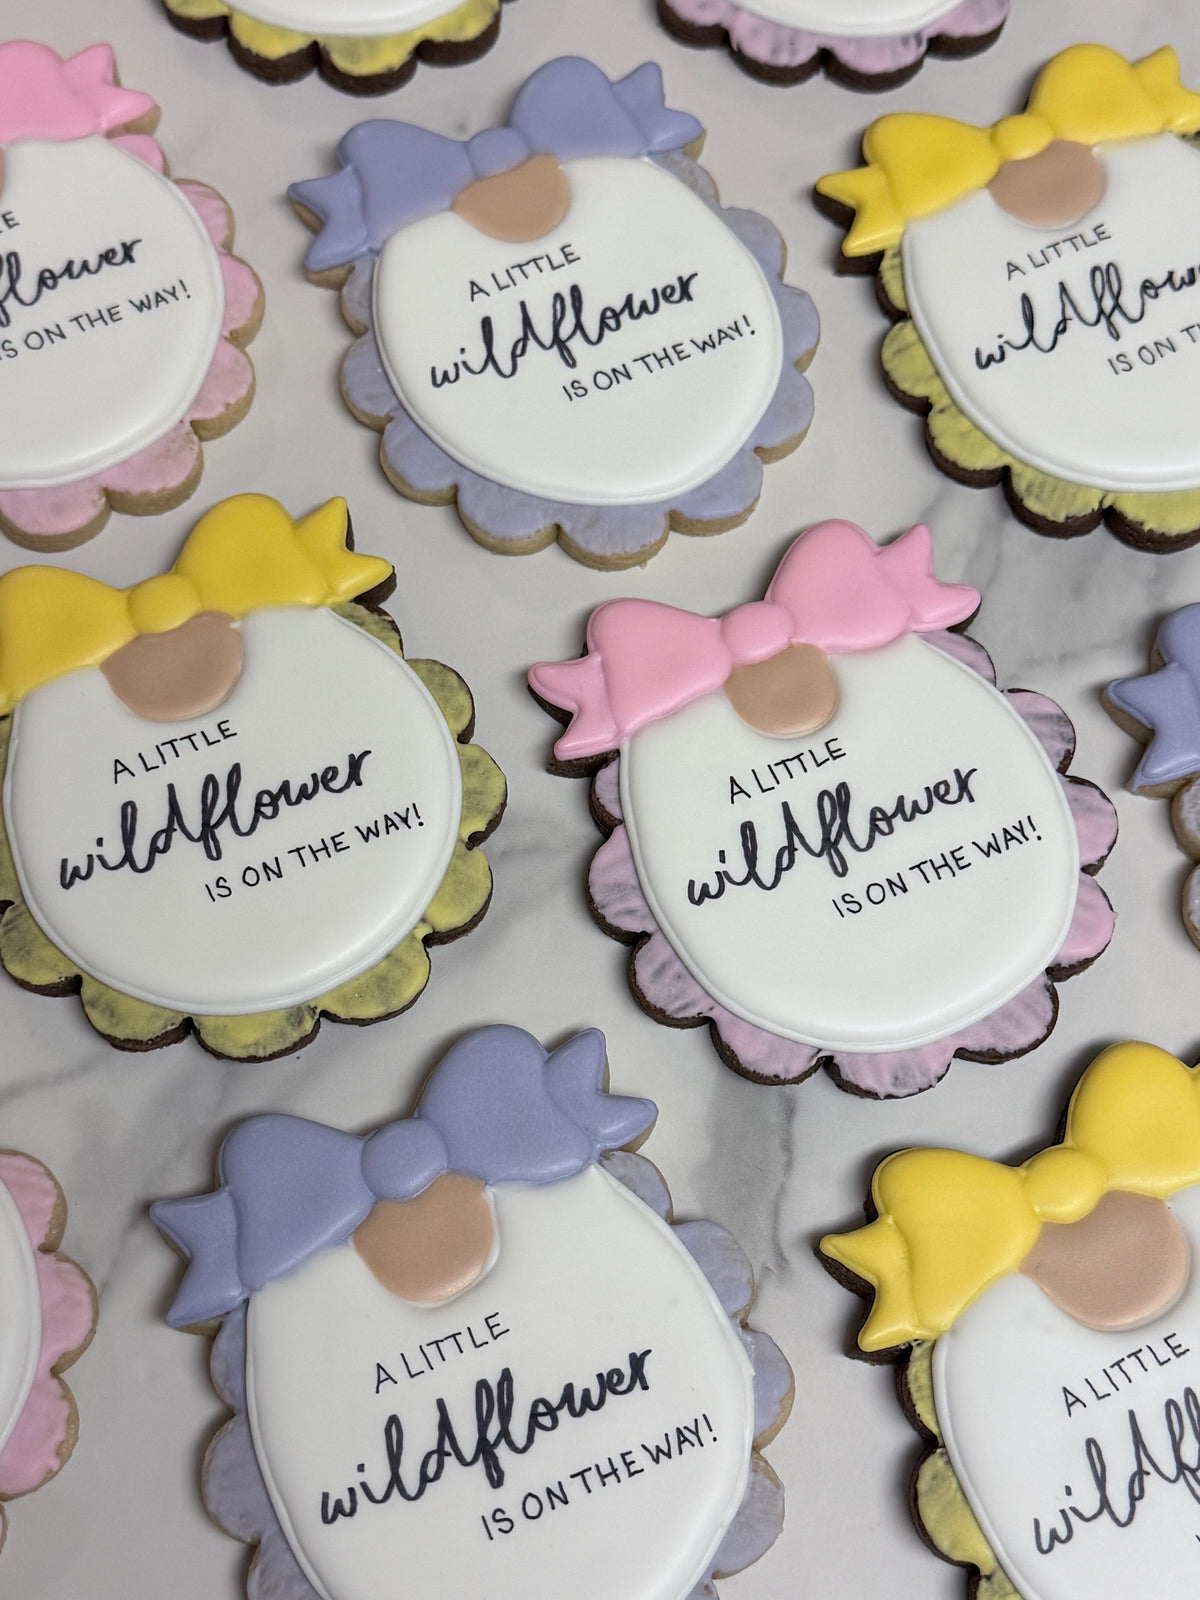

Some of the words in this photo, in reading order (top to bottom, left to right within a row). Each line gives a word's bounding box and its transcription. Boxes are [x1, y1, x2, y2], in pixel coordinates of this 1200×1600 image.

[468, 279, 491, 303] A
[490, 243, 582, 292] LITTLE
[1006, 261, 1027, 282] A
[1026, 223, 1112, 269] LITTLE
[0, 339, 19, 359] S
[23, 323, 67, 351] ON
[68, 304, 124, 332] THE
[127, 279, 192, 314] WAY!
[430, 272, 699, 389] wildflower
[561, 379, 589, 402] IS
[592, 362, 633, 391] ON
[632, 342, 692, 374] THE
[689, 314, 757, 354] WAY!
[974, 261, 1200, 371] wildflow
[1107, 352, 1134, 376] IS
[1137, 336, 1177, 366] ON
[113, 758, 136, 785] A
[137, 719, 238, 773] LITTLE
[729, 775, 752, 805] A
[750, 737, 847, 794] LITTLE
[59, 749, 373, 891] wildflower
[204, 875, 233, 903] IS
[241, 856, 284, 888] ON
[286, 831, 351, 869] THE
[354, 802, 425, 844] WAY!
[687, 767, 979, 907] wildflower
[831, 892, 863, 919] IS
[865, 871, 909, 906] ON
[908, 845, 972, 885] THE
[971, 814, 1043, 859] WAY!
[375, 1362, 399, 1395] A
[399, 1311, 511, 1379] LITTLE
[1061, 1385, 1088, 1419] A
[1083, 1332, 1191, 1401] LITTLE
[320, 1348, 653, 1526] wildflower
[480, 1507, 515, 1541] IS
[521, 1480, 570, 1521] ON
[569, 1450, 645, 1495] THE
[640, 1413, 719, 1465] WAY!
